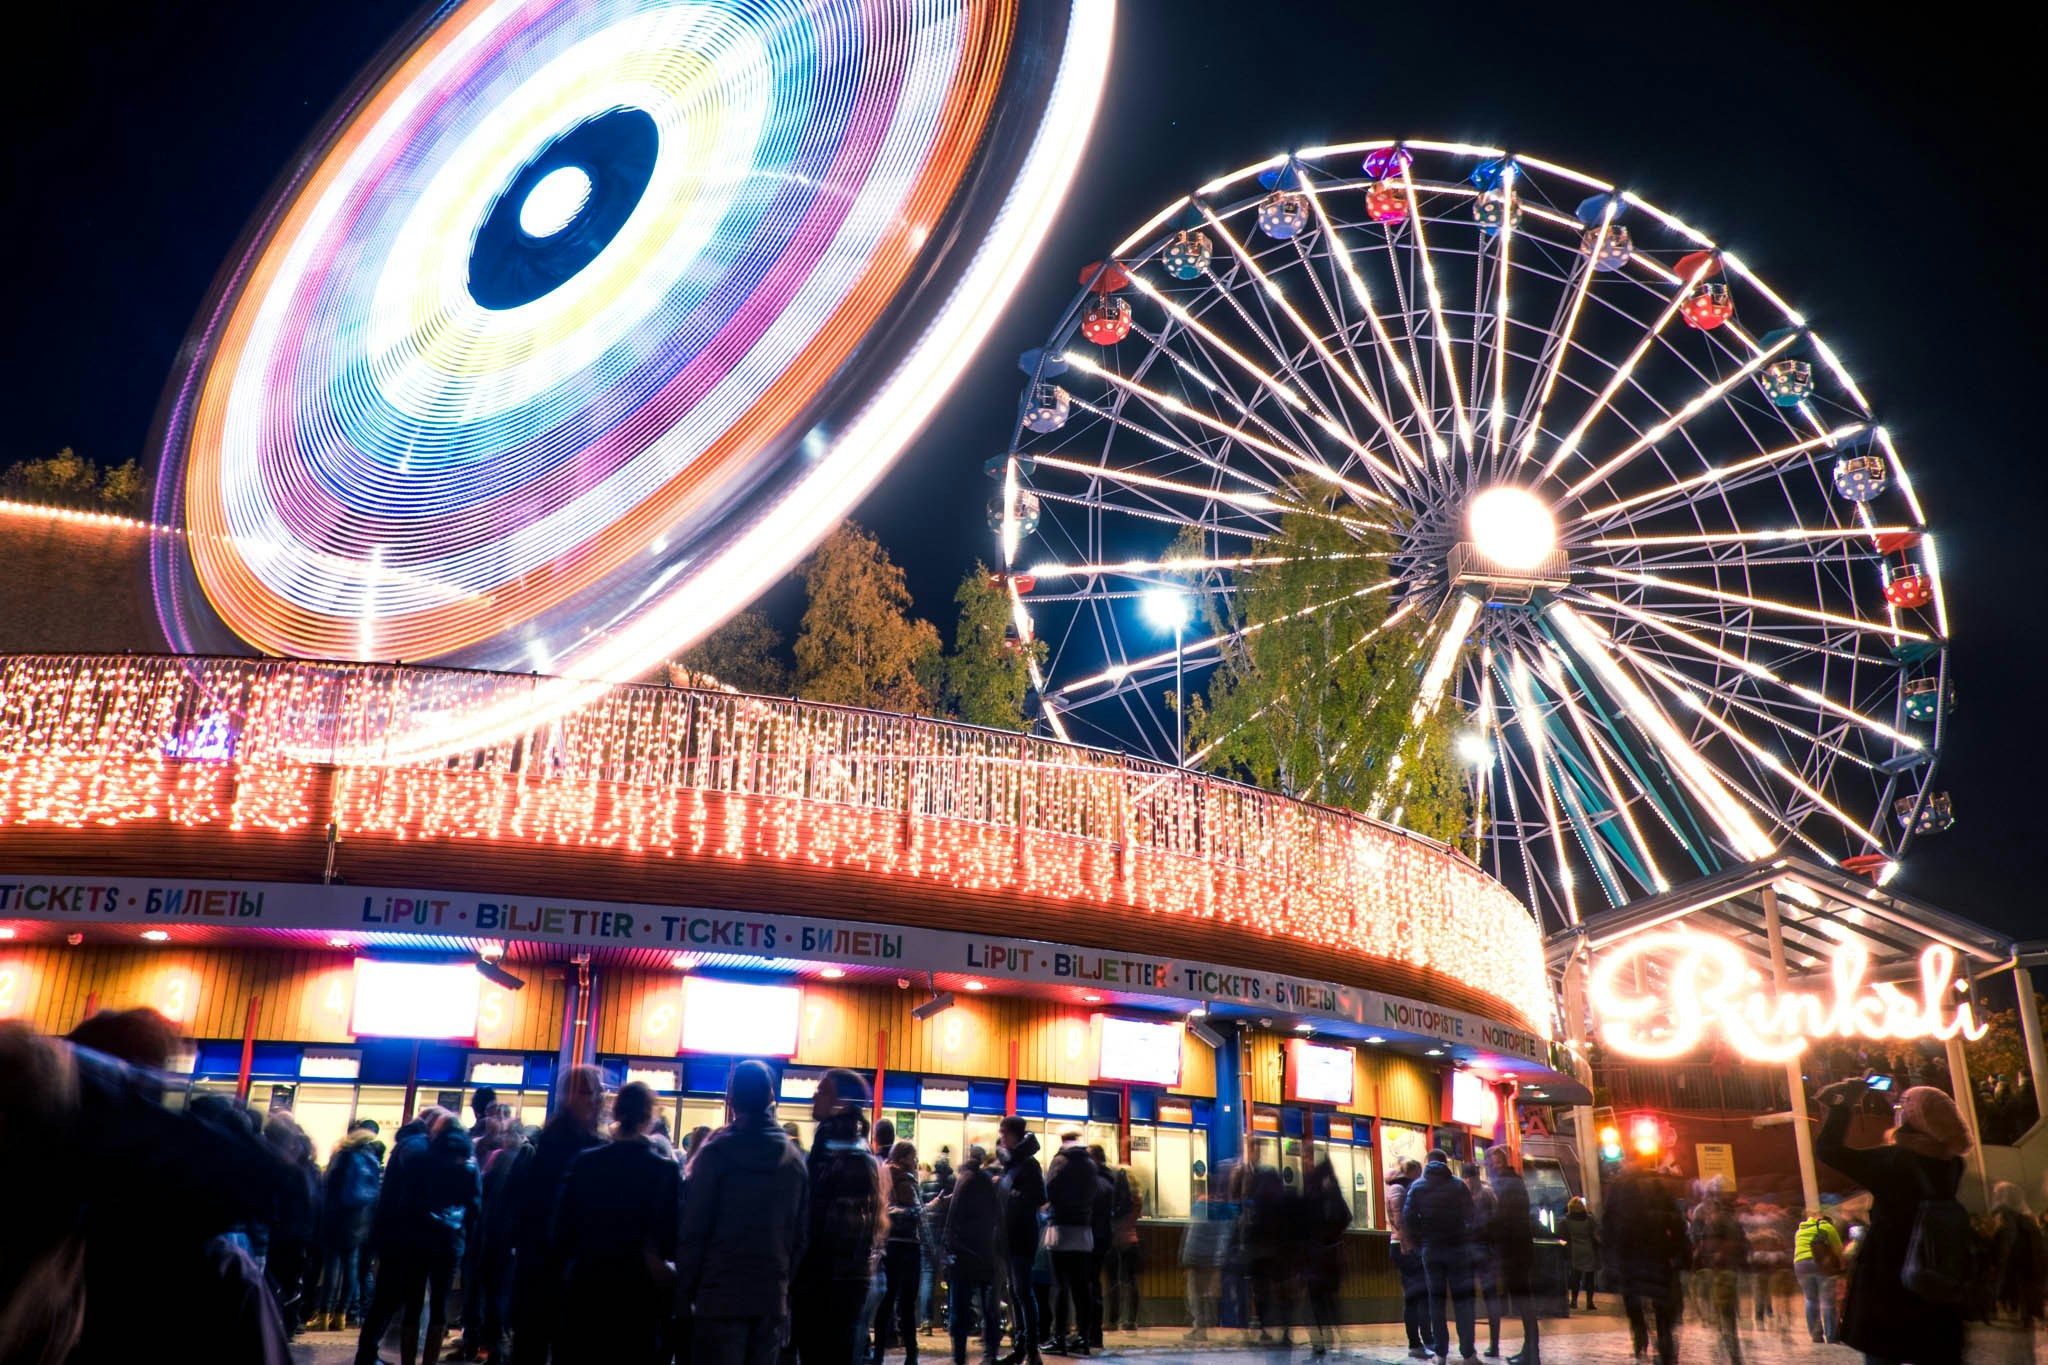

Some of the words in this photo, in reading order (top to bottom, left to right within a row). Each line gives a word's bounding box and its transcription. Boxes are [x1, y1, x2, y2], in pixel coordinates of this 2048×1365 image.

[145, 887, 264, 917] БИЛЕТЫ
[801, 927, 902, 959] БИЛЕТЫ
[1275, 982, 1336, 1011] БИЛЕТЫ
